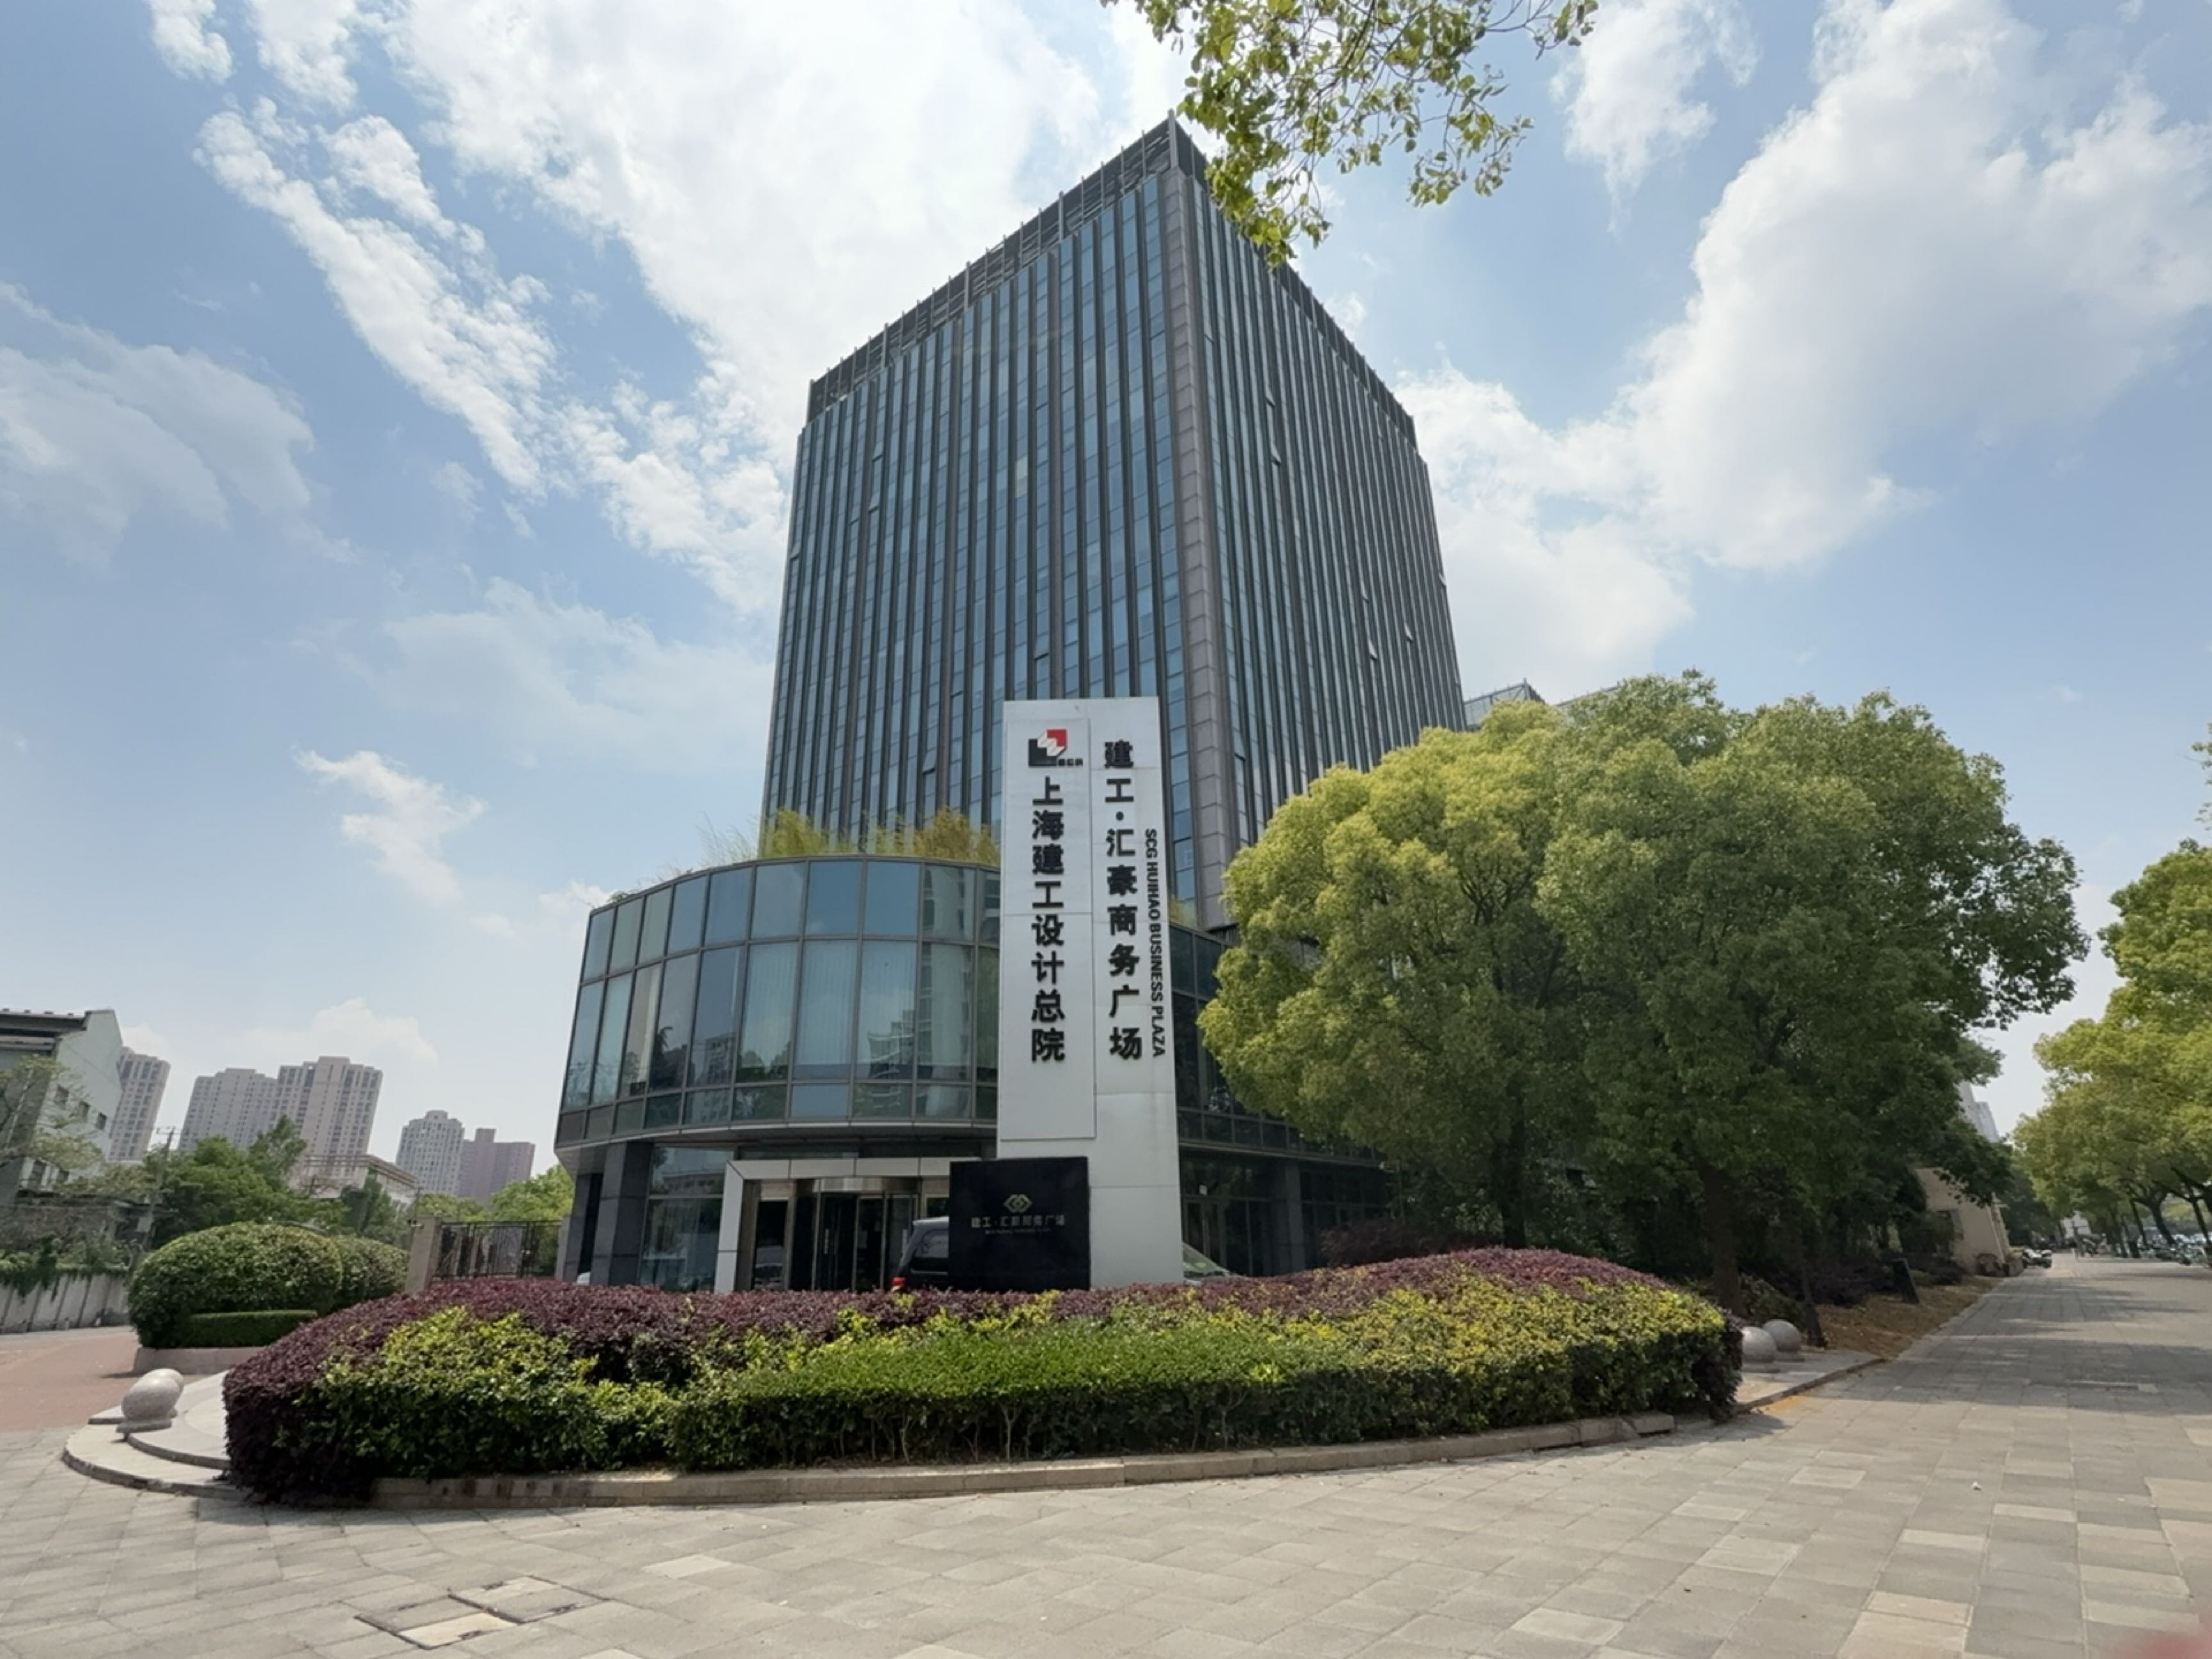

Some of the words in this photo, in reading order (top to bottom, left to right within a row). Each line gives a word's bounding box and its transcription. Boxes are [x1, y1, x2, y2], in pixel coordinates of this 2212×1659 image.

[1146, 829, 1157, 858] SCG
[1031, 775, 1065, 1062] 上海建工设计总院
[1147, 862, 1160, 920] HUIHAO
[1149, 923, 1164, 1002] BUSINESS
[1152, 1006, 1166, 1057] PLAZA
